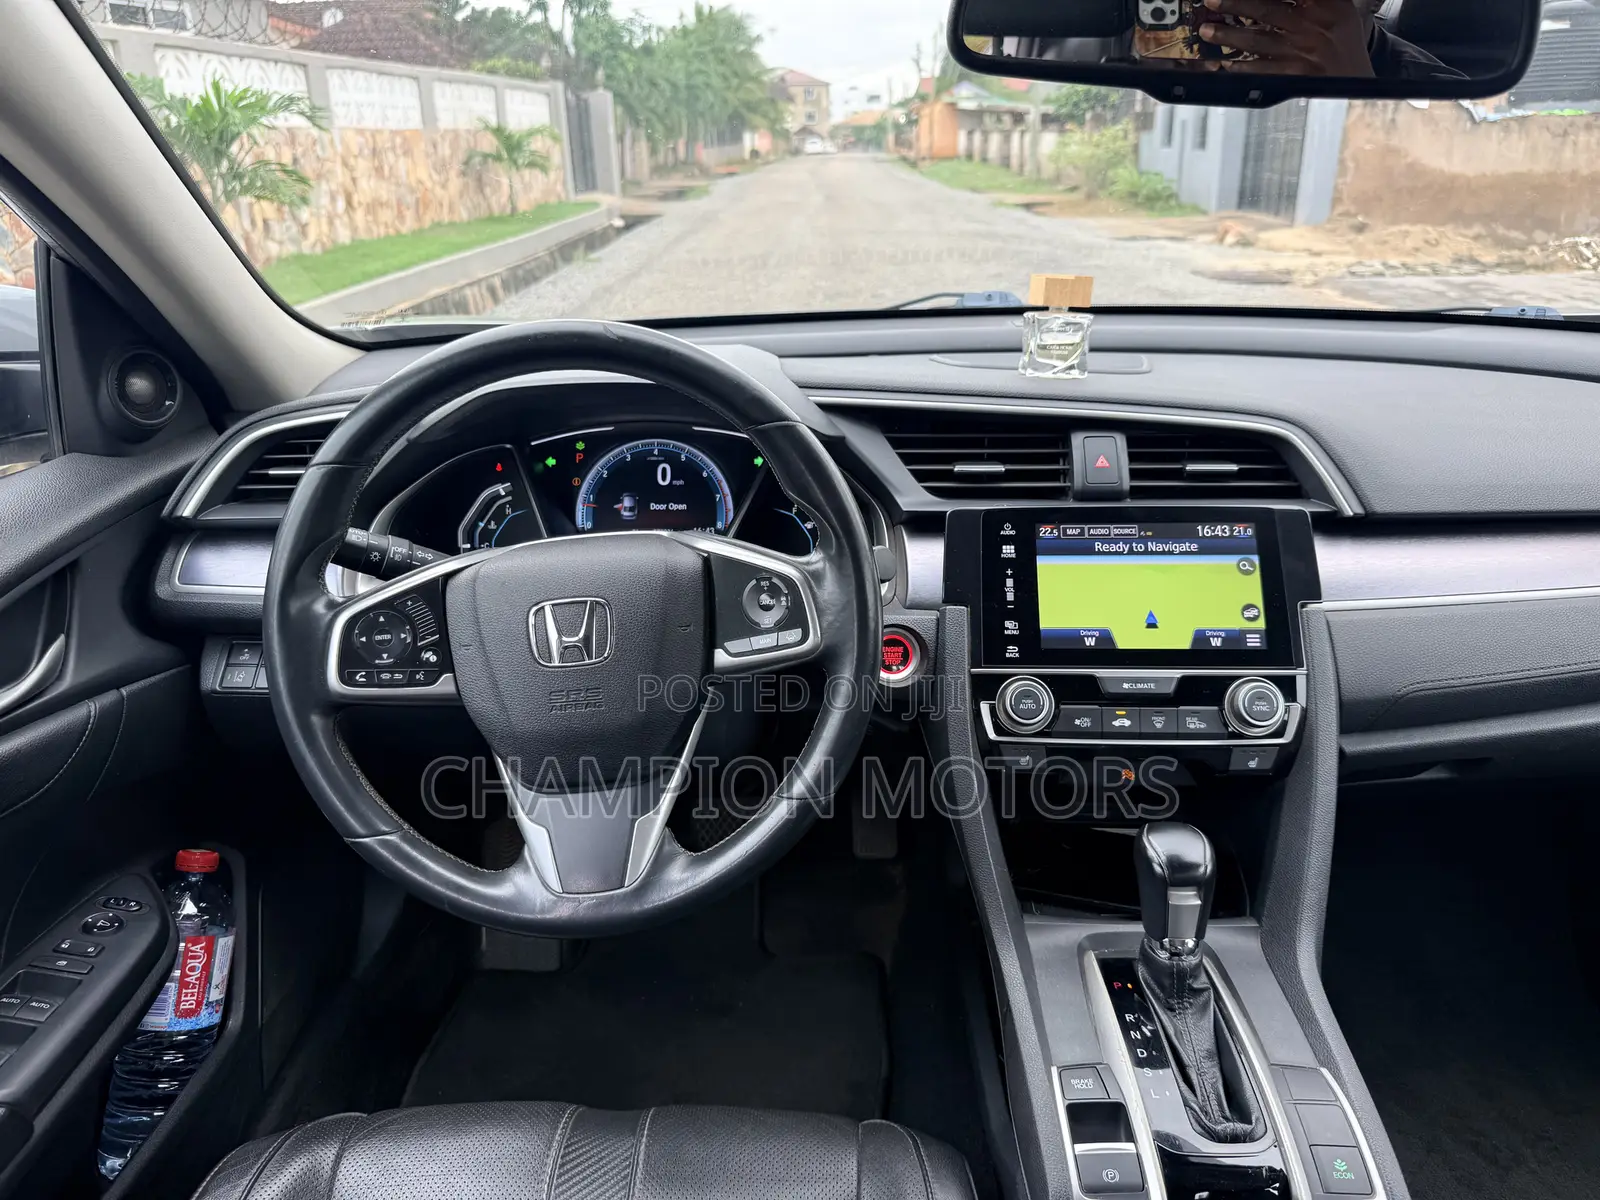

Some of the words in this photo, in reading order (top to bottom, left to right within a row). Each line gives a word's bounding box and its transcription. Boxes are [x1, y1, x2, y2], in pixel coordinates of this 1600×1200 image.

[576, 453, 584, 463] P
[656, 463, 671, 486] 0
[672, 479, 685, 487] mph
[650, 503, 667, 511] Door
[668, 503, 687, 512] Open
[1039, 527, 1058, 537] 22.5
[1196, 525, 1229, 537] 16:43
[1232, 526, 1252, 536] 21.0
[394, 546, 408, 554] OFF
[1094, 541, 1129, 554] Ready
[1132, 543, 1145, 552] to
[1148, 541, 1199, 555] Navigate
[374, 633, 392, 641] ENTER
[1080, 629, 1099, 637] Driving
[1205, 629, 1225, 637] Driving
[1084, 636, 1096, 646] W
[1209, 637, 1222, 647] W
[1128, 682, 1156, 690] CLIMATE
[548, 687, 603, 701] SRS
[548, 701, 605, 714] AIRBAG
[1113, 982, 1122, 990] P
[29, 1001, 50, 1009] AUTO
[1124, 1013, 1135, 1022] R
[1130, 1030, 1141, 1040] N
[1136, 1048, 1148, 1058] D
[1143, 1067, 1153, 1077] S
[1150, 1088, 1160, 1098] L
[1332, 1171, 1355, 1180] ECON
